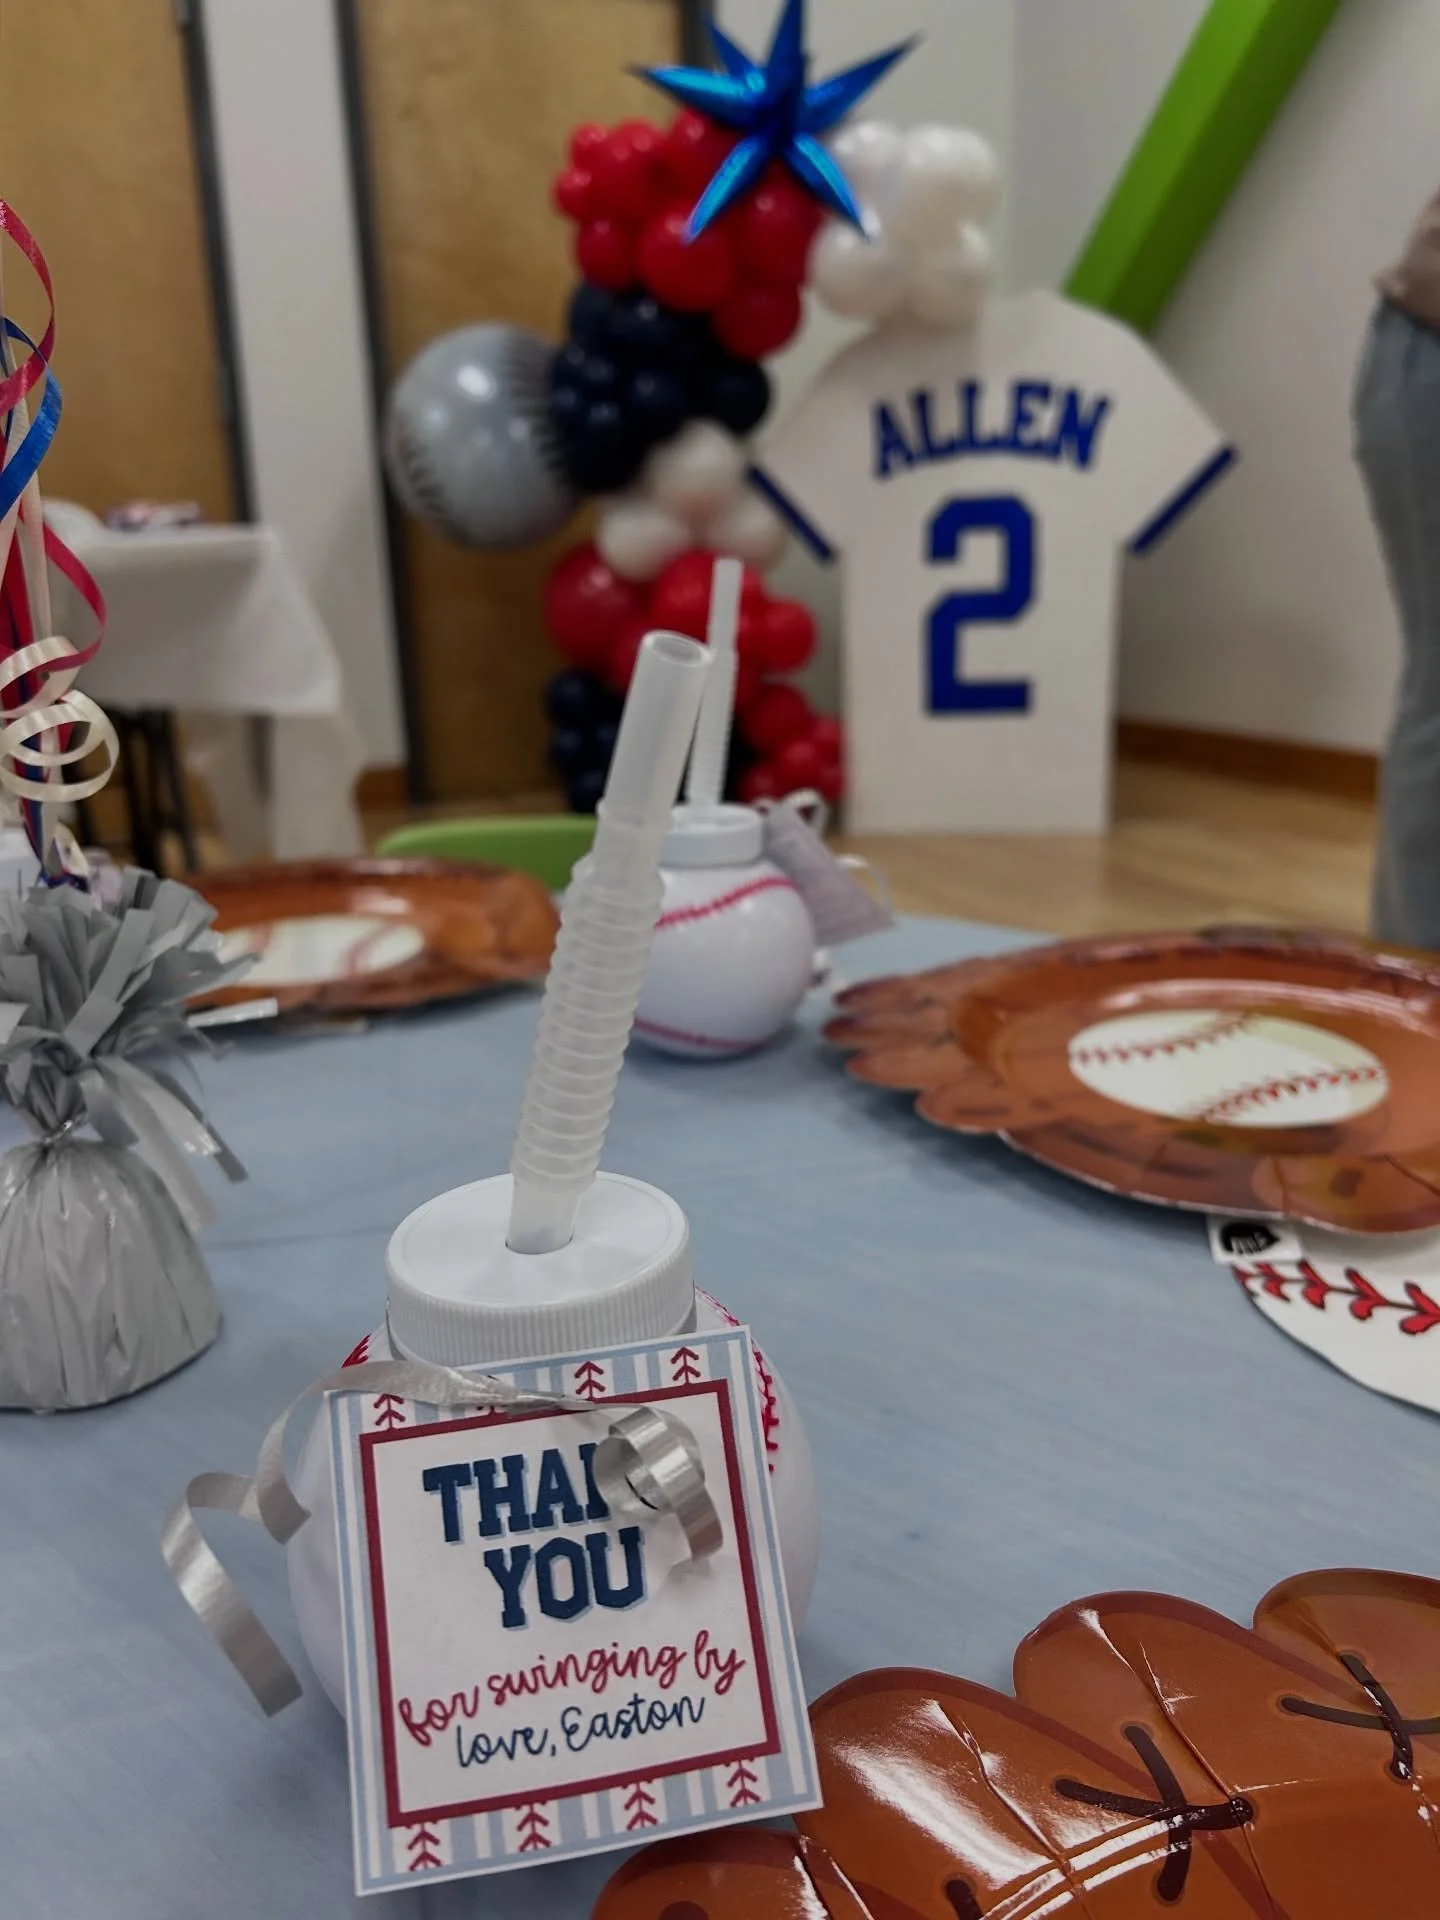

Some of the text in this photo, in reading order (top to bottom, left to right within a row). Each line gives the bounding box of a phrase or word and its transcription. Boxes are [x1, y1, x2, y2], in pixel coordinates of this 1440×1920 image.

[871, 378, 1110, 478] ALLEN
[926, 495, 1036, 714] 2
[484, 1526, 645, 1629] YOU
[398, 1629, 746, 1746] for swinging by
